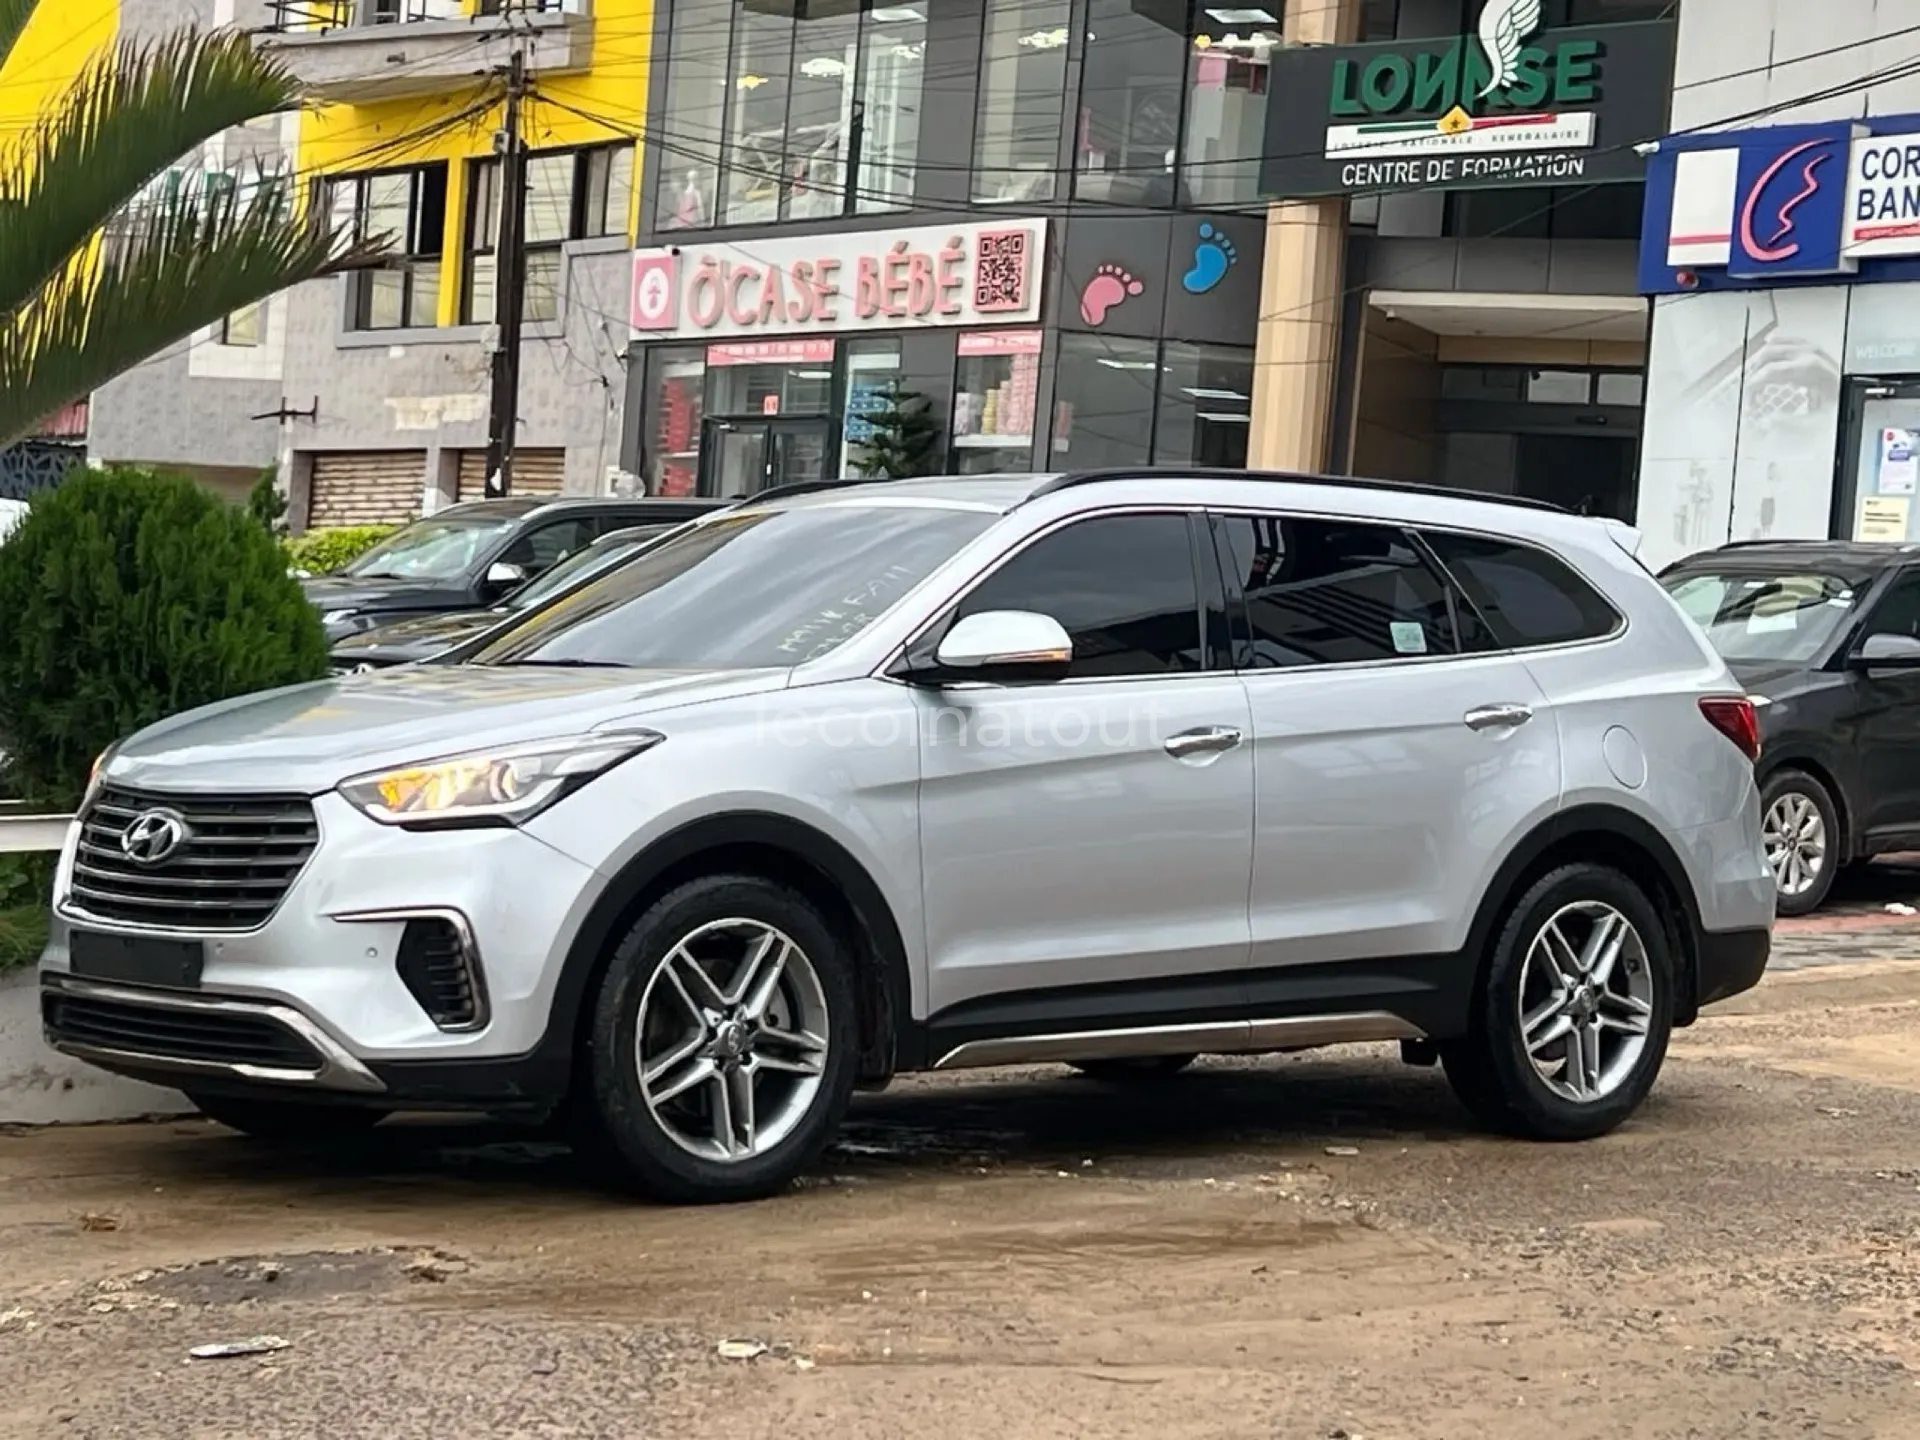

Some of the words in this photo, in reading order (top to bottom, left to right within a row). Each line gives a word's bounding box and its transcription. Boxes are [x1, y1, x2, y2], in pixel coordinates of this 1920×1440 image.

[1341, 160, 1421, 186] CENTRE
[1426, 158, 1455, 182] DE
[1861, 145, 1920, 180] COR
[1857, 185, 1920, 220] BAN
[855, 235, 967, 321] BÉBÉ
